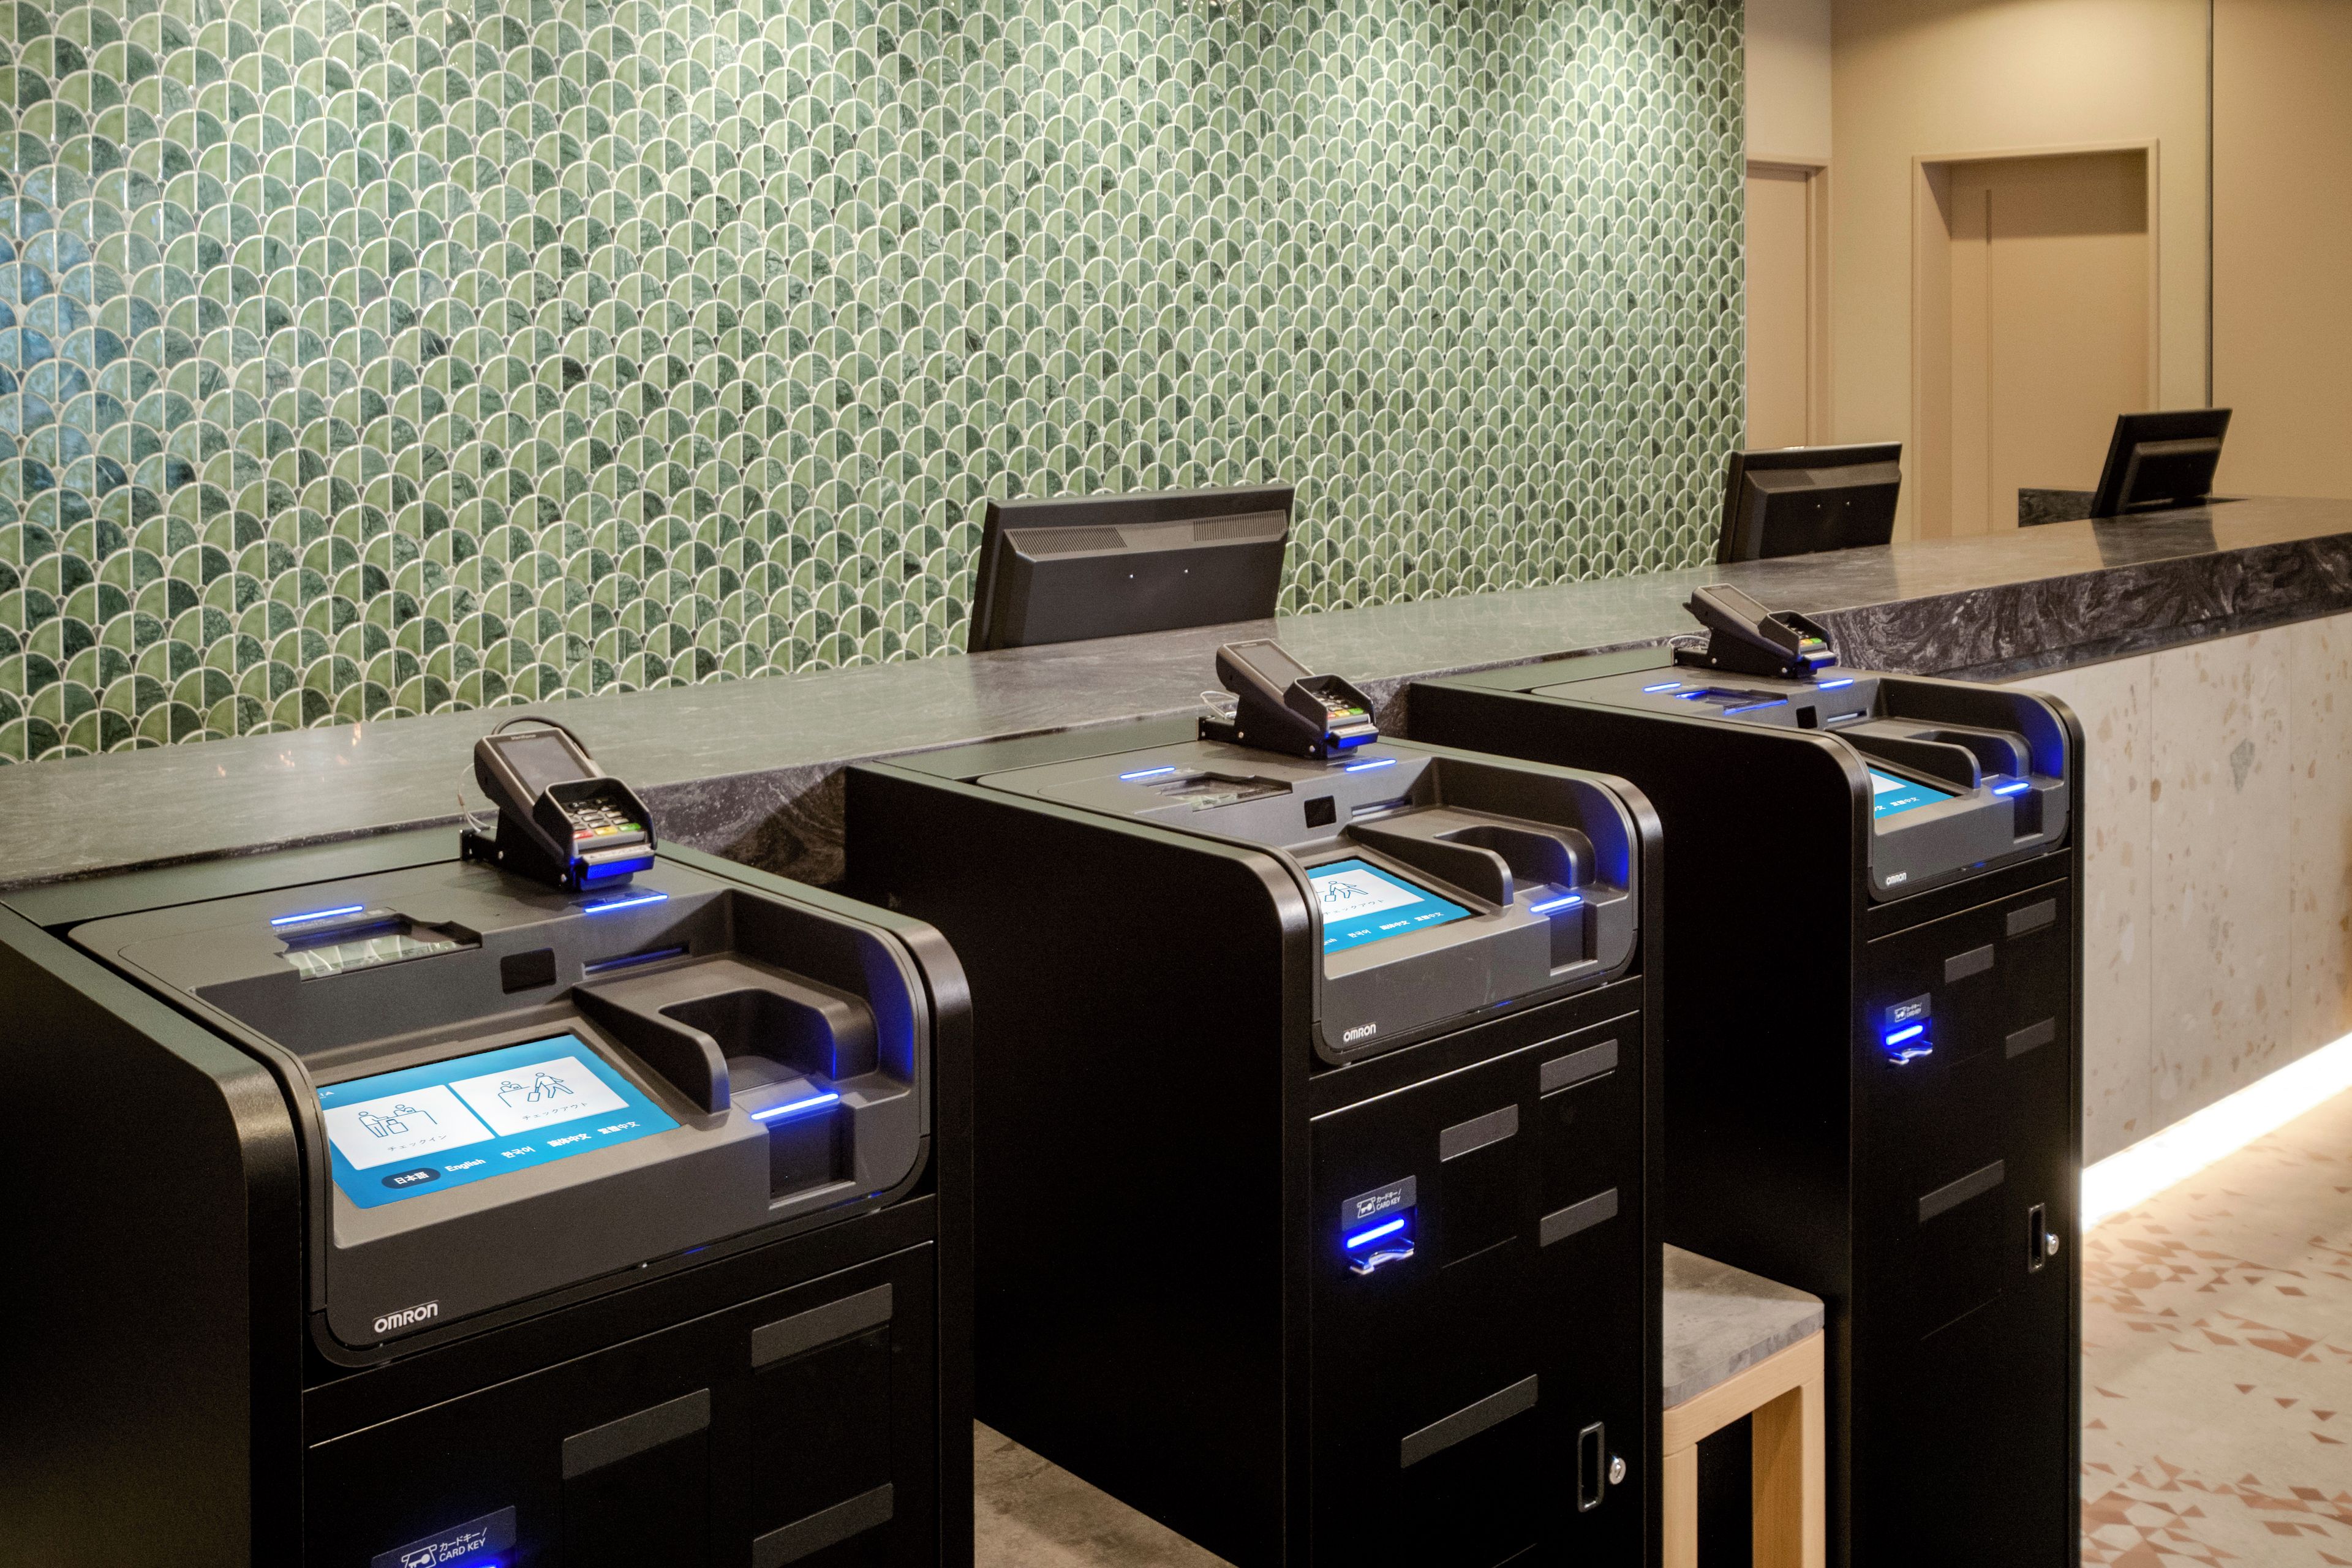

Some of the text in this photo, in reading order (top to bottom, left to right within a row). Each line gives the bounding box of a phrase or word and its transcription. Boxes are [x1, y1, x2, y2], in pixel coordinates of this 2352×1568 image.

[1348, 929, 1371, 938] 한국어
[1343, 1023, 1376, 1042] OMRON
[522, 1102, 587, 1120] チェックアウト
[388, 1134, 447, 1152] チェックイン
[500, 1146, 536, 1158] 한국어
[445, 1159, 486, 1172] English
[394, 1171, 429, 1185] 日本語
[1376, 1196, 1401, 1211] CARD KEY
[374, 1302, 439, 1333] OMRON
[439, 1537, 486, 1562] CARD KEY
